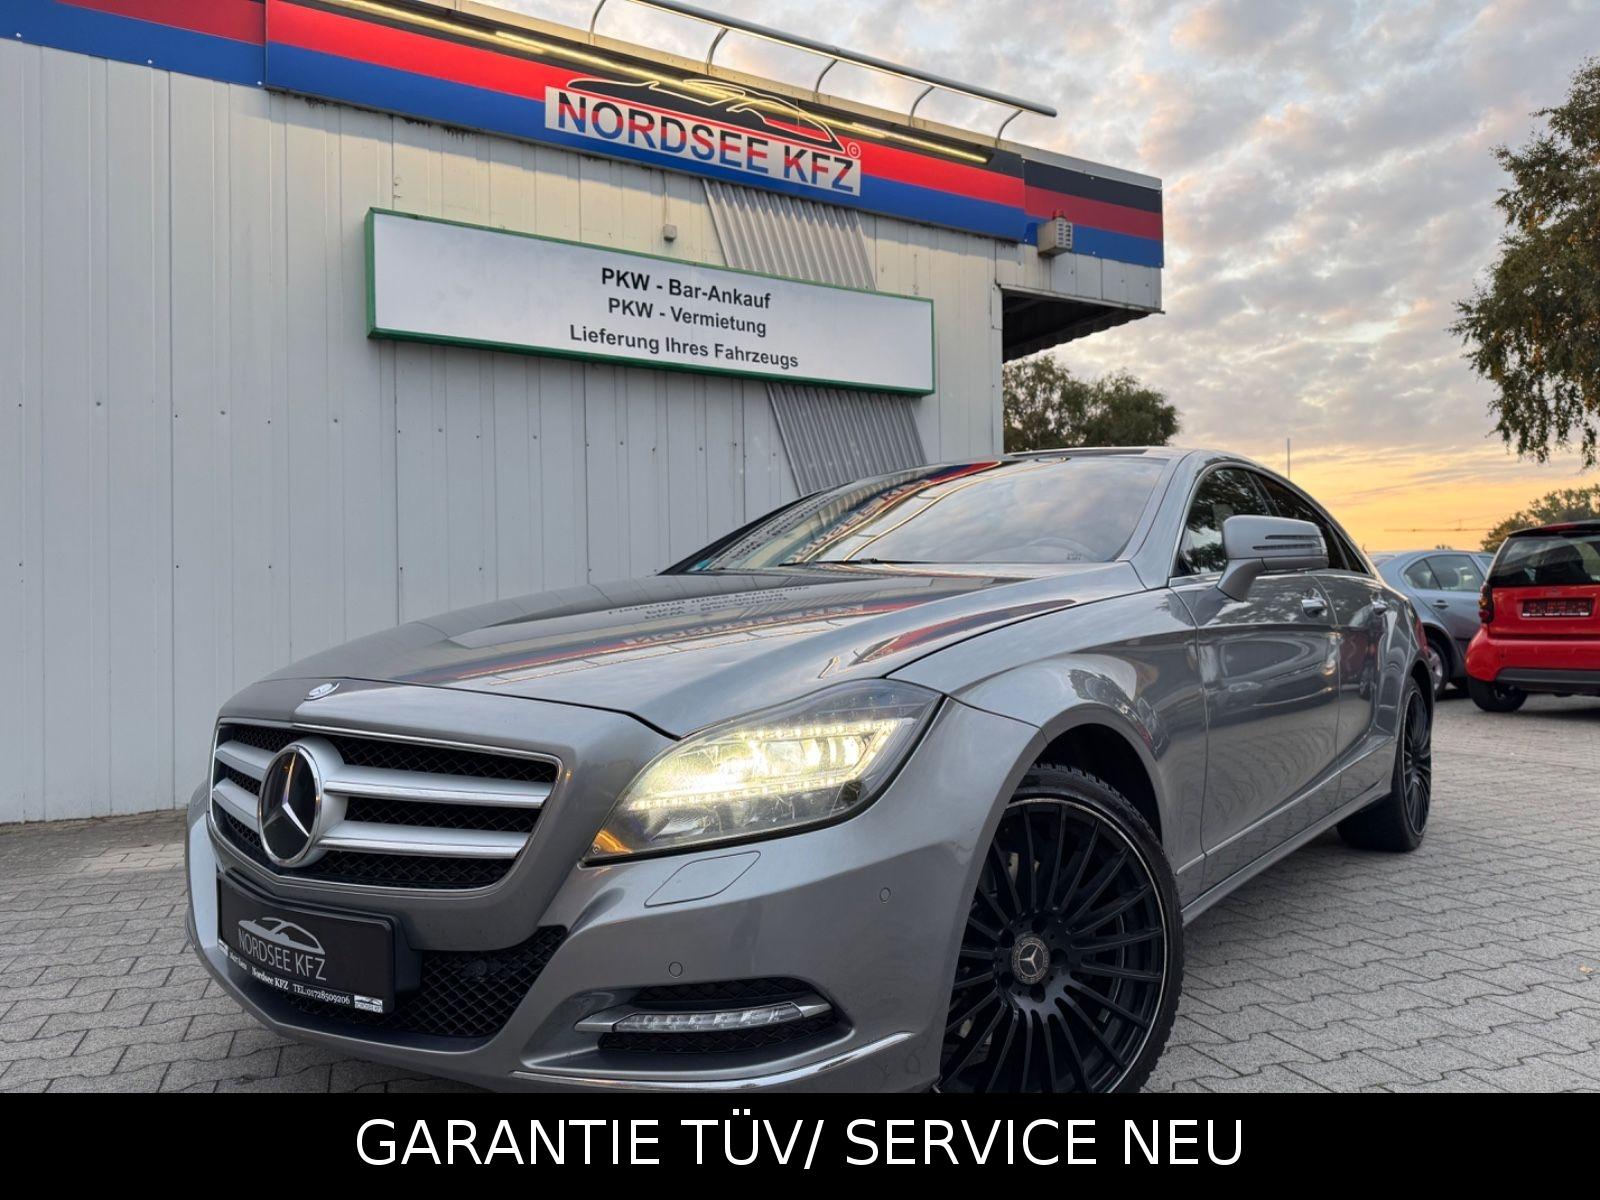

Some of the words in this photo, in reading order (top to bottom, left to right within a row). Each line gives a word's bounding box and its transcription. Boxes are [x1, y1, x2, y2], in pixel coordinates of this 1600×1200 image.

[558, 91, 769, 174] NORDSEE
[783, 145, 854, 193] KFZ
[601, 267, 650, 291] PKW
[668, 279, 772, 309] Bar-Ankauf
[608, 297, 654, 318] PKW
[670, 306, 767, 338] Vermietung
[570, 324, 660, 354] Lieferung
[666, 337, 709, 357] Ihres
[714, 344, 799, 370] Fahrzeugs
[238, 928, 292, 973] NORDSEE
[295, 952, 327, 981] KFZ
